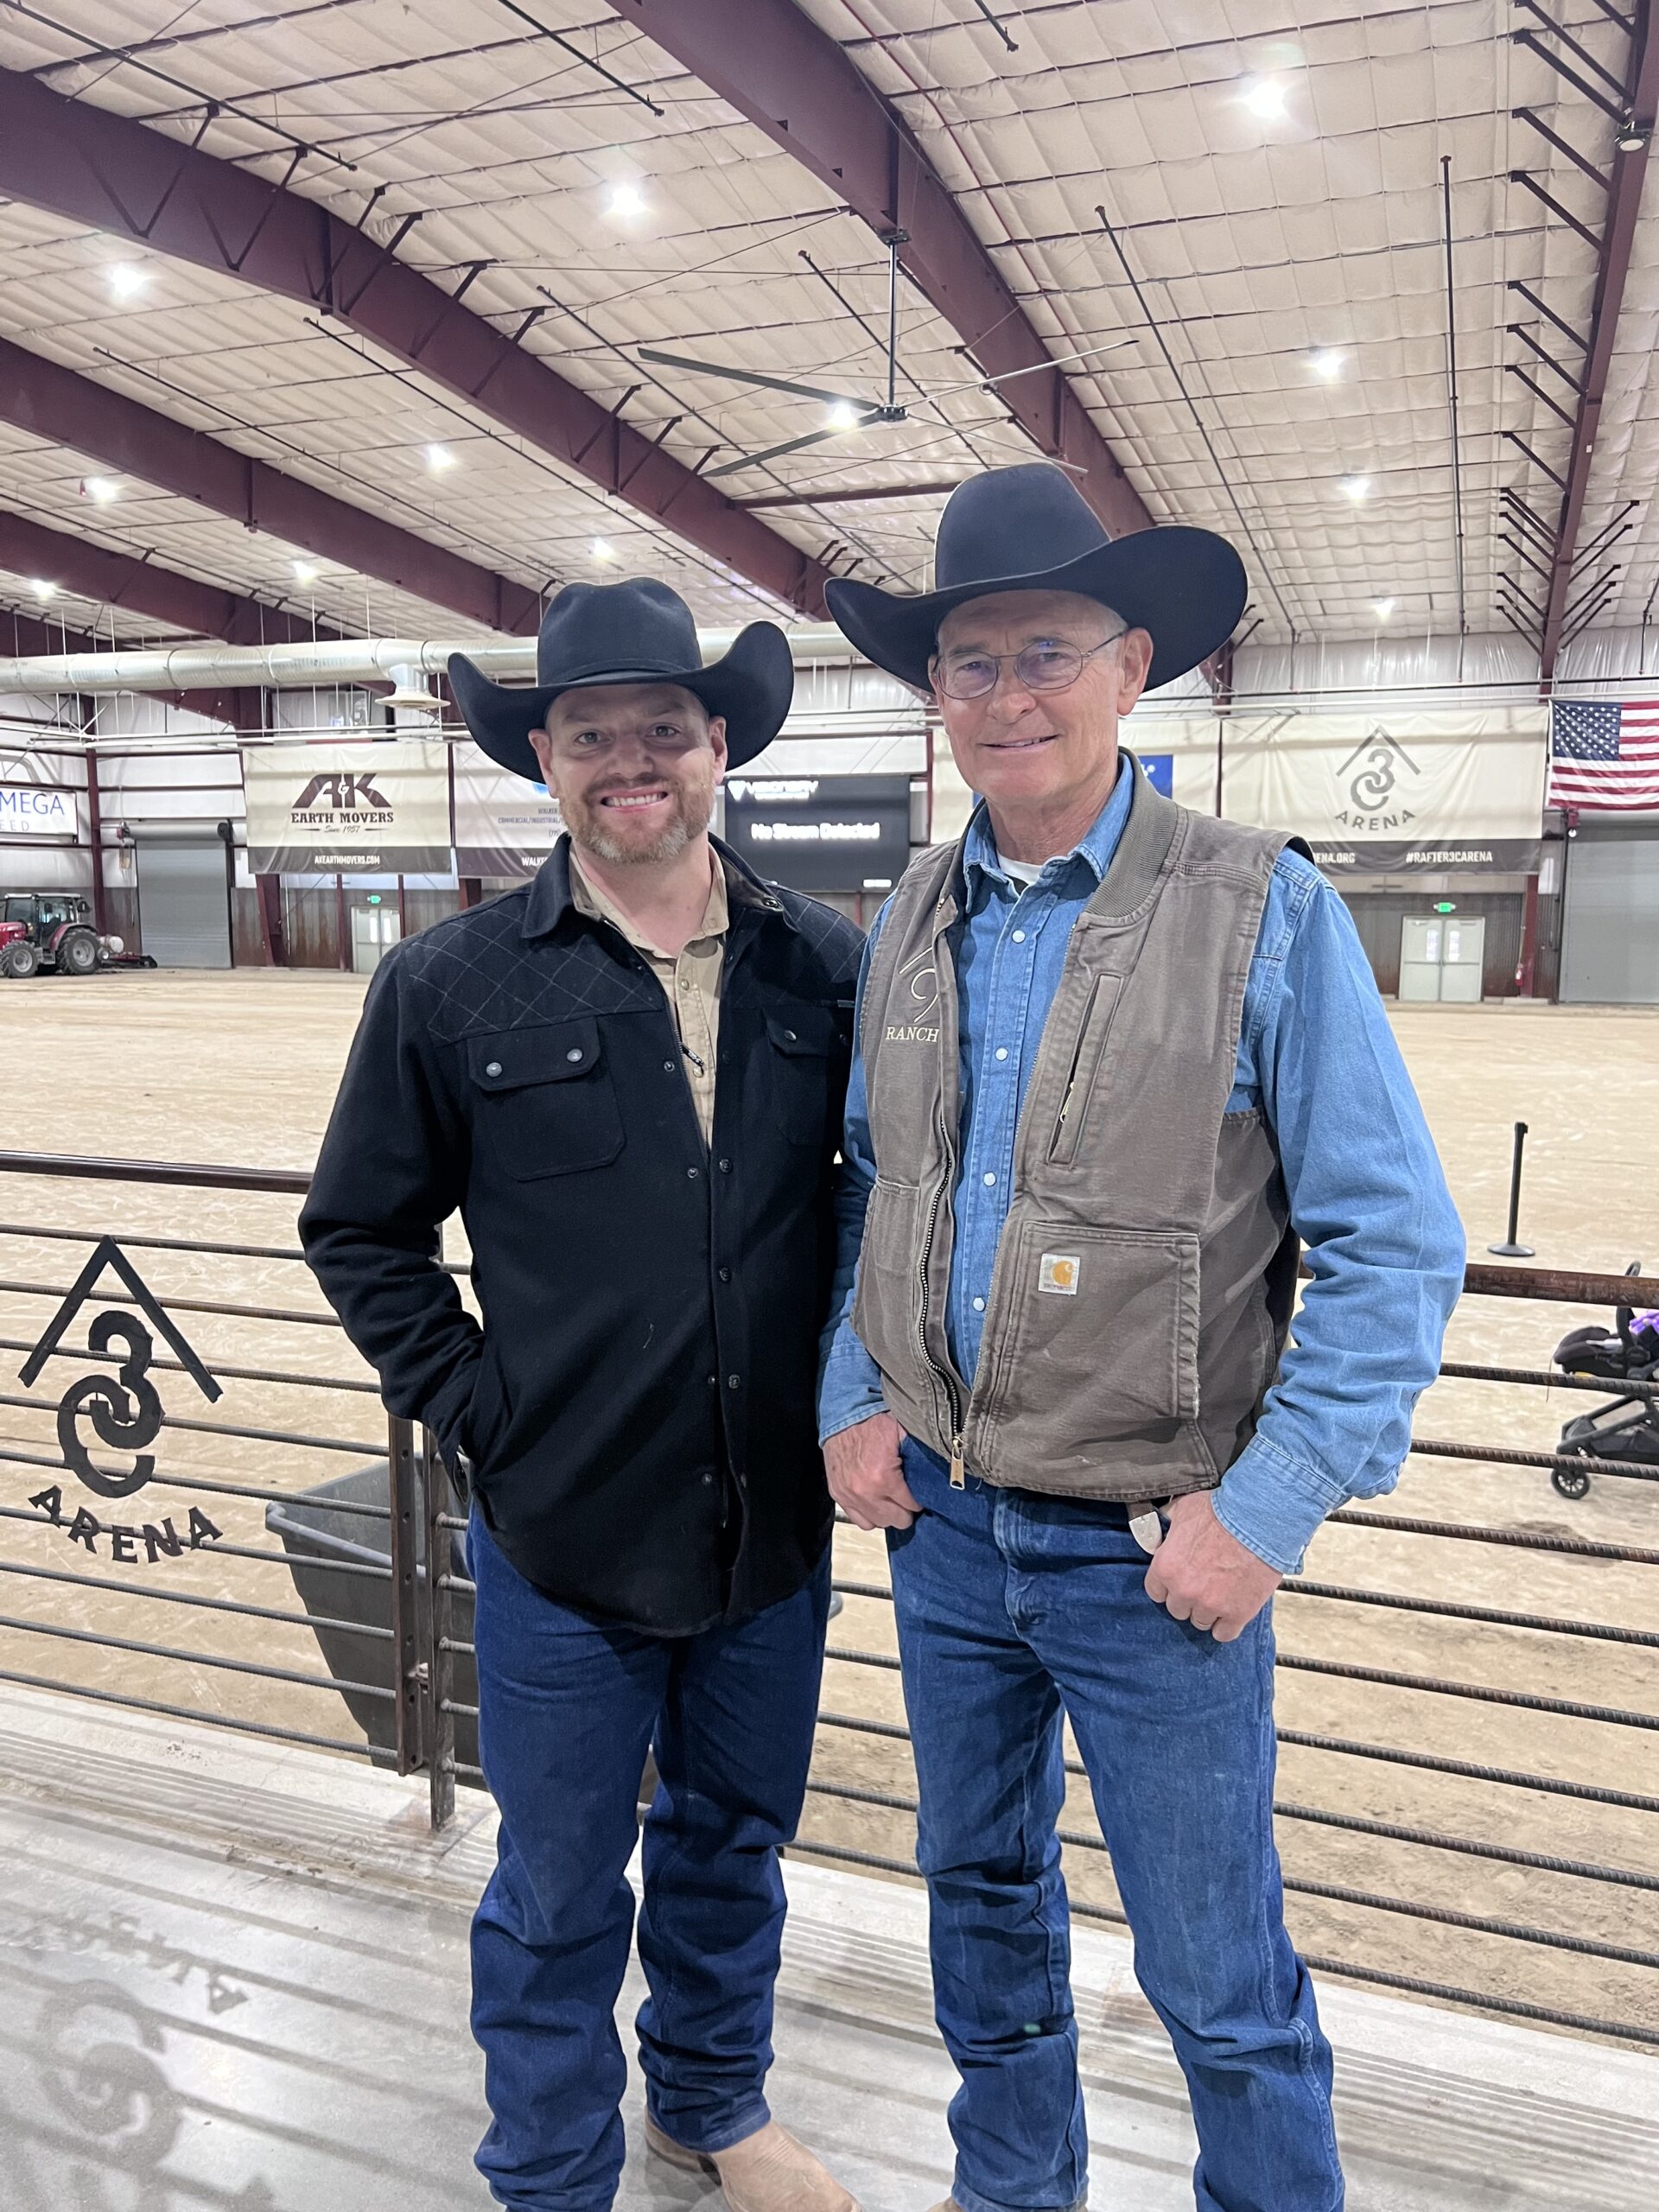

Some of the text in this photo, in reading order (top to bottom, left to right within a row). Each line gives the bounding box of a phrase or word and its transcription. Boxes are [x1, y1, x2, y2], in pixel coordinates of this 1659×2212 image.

[291, 812, 394, 823] EARTH MOVERS
[1334, 809, 1416, 830] ARENA
[315, 855, 380, 865] AKEARTHMOVERS.COM
[1313, 852, 1356, 864] ENA.ORG
[1406, 851, 1493, 863] #RAFTER3CARENA
[885, 1026, 940, 1043] RANCH
[28, 1484, 224, 1564] ARENA
